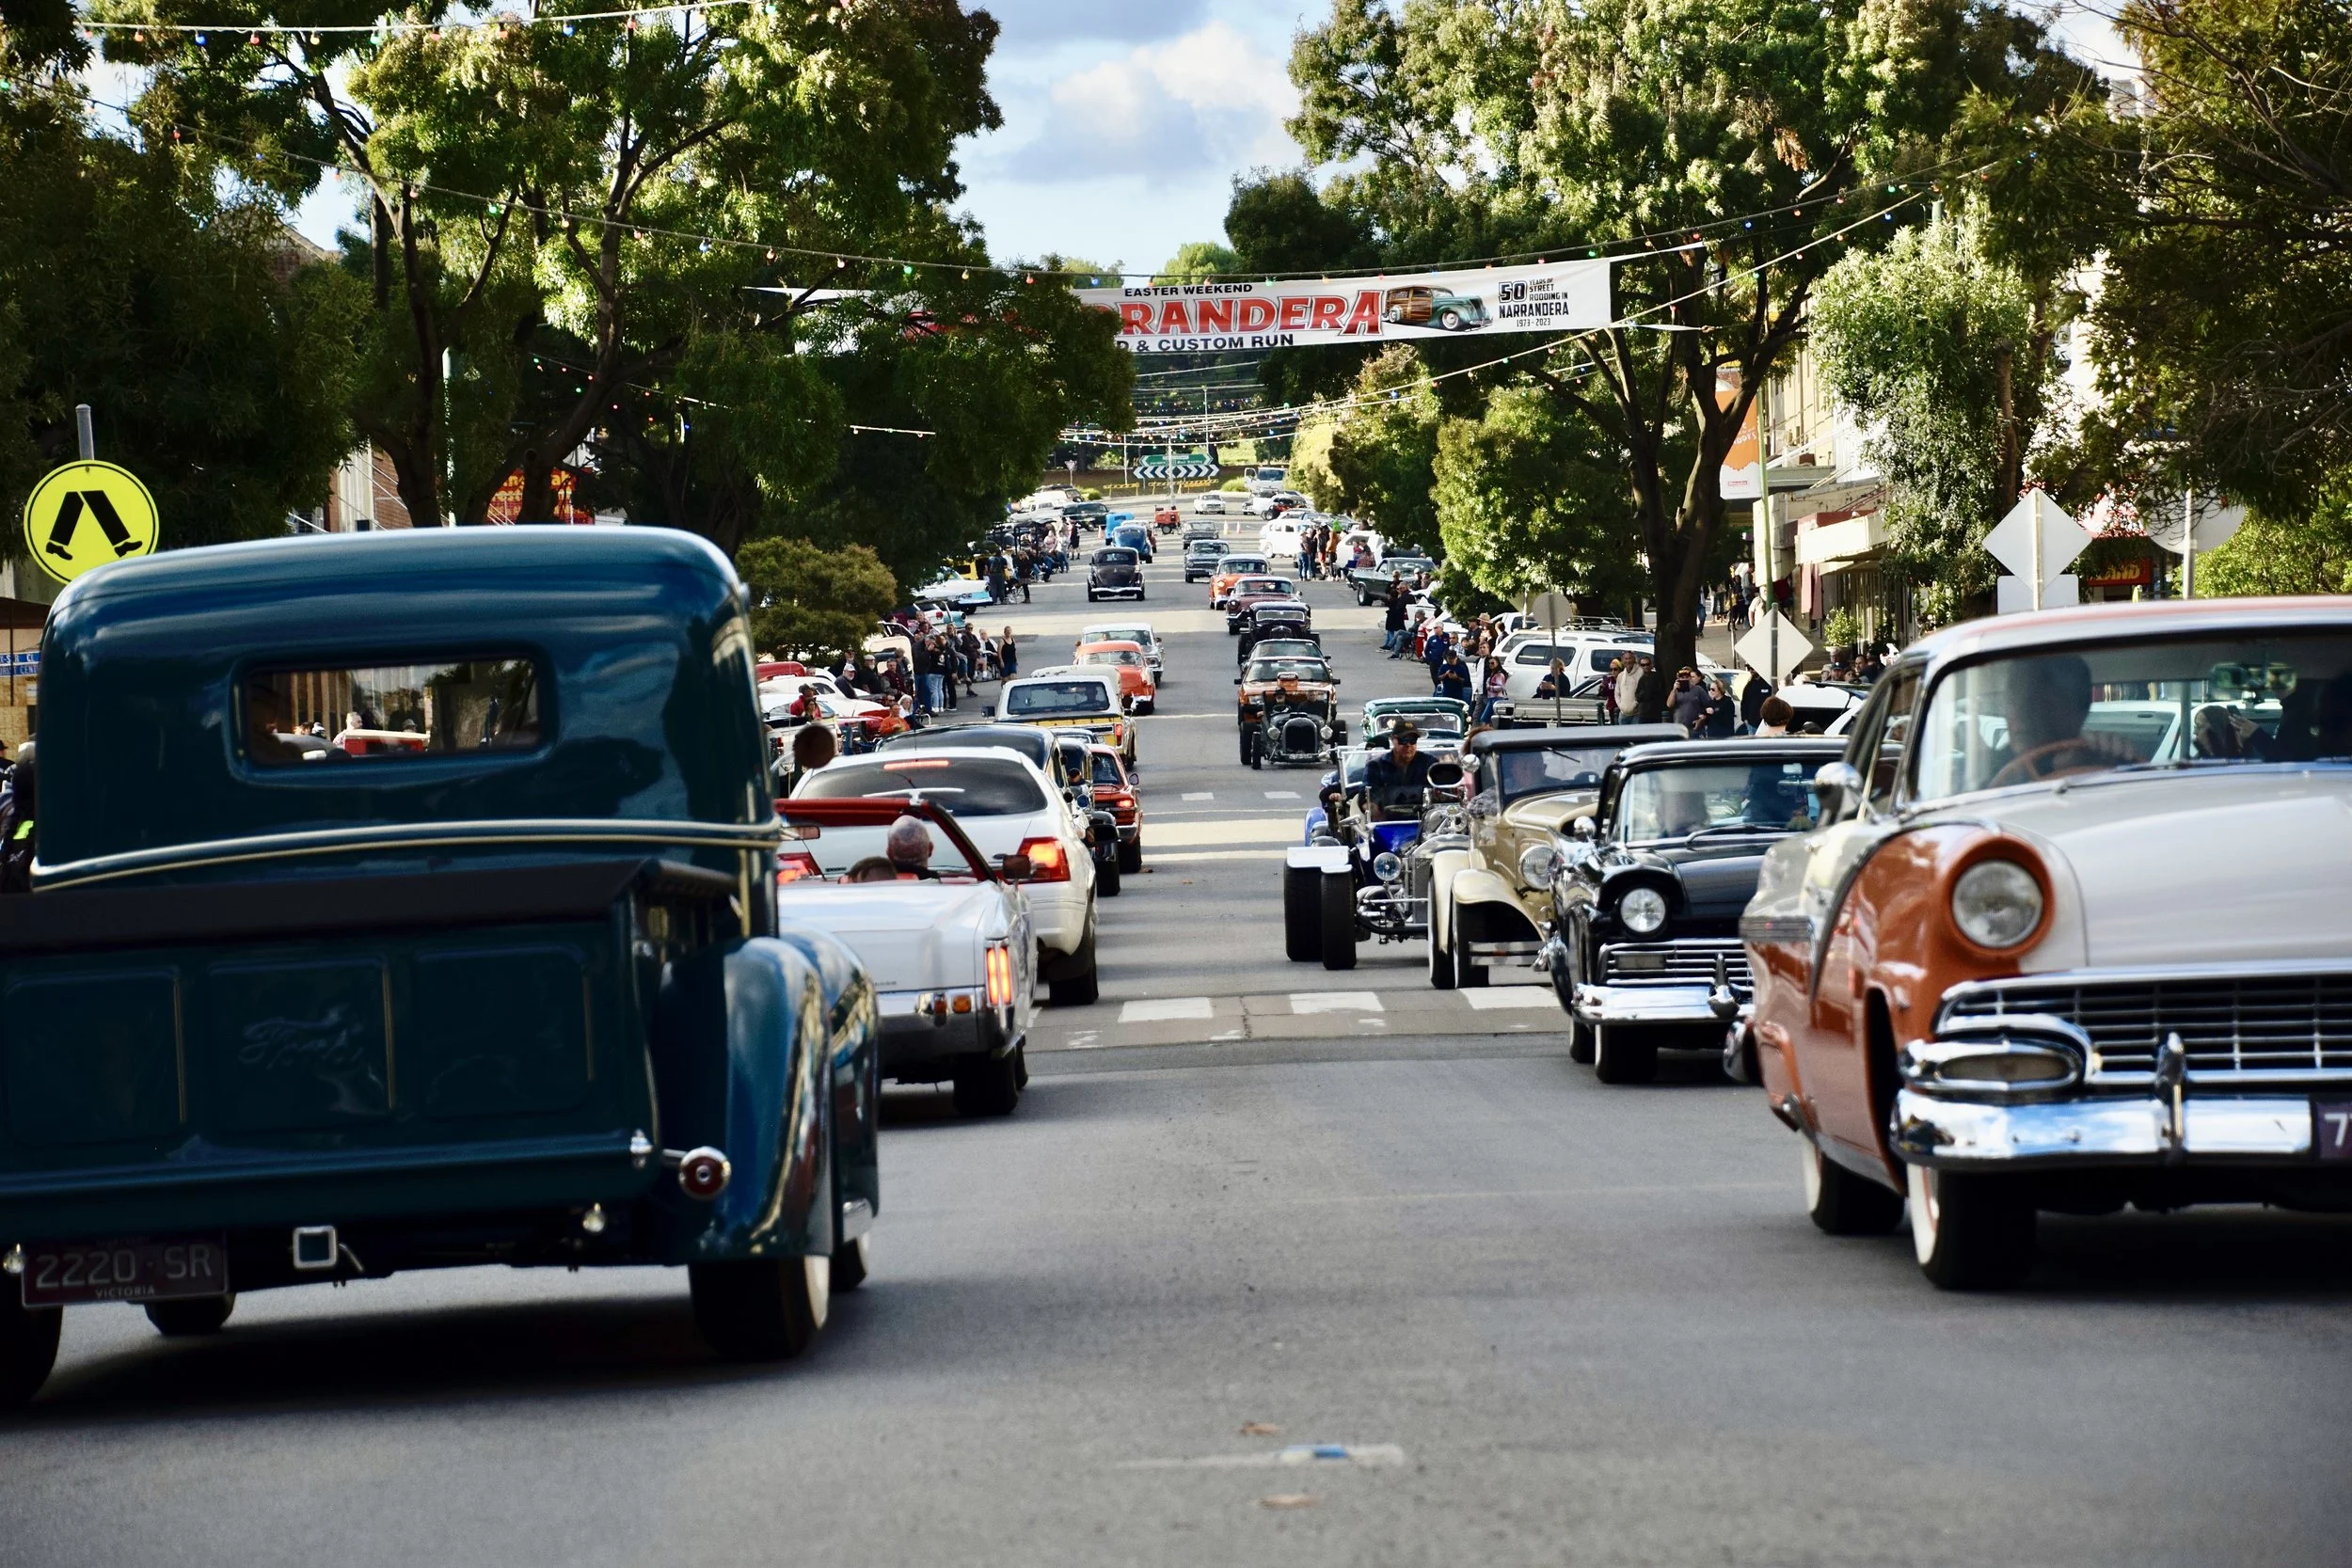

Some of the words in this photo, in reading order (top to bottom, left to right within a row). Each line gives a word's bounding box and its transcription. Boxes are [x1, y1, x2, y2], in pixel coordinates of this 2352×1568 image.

[1124, 287, 1179, 297] EASTER
[1184, 284, 1253, 295] WEEKEND
[1499, 280, 1528, 303] 50
[1529, 284, 1554, 293] STREET
[1562, 292, 1568, 300] IN
[1084, 290, 1384, 337] RANDERA
[1499, 302, 1569, 319] NARRANDERA
[1517, 319, 1531, 327] 1973
[1535, 318, 1551, 326] 2023
[1136, 340, 1150, 352] &
[1158, 337, 1244, 352] CUSTOM
[1251, 334, 1294, 347] RUN
[36, 1249, 136, 1290] 2220
[164, 1243, 213, 1279] SR
[95, 1284, 155, 1299] VICTORIA
